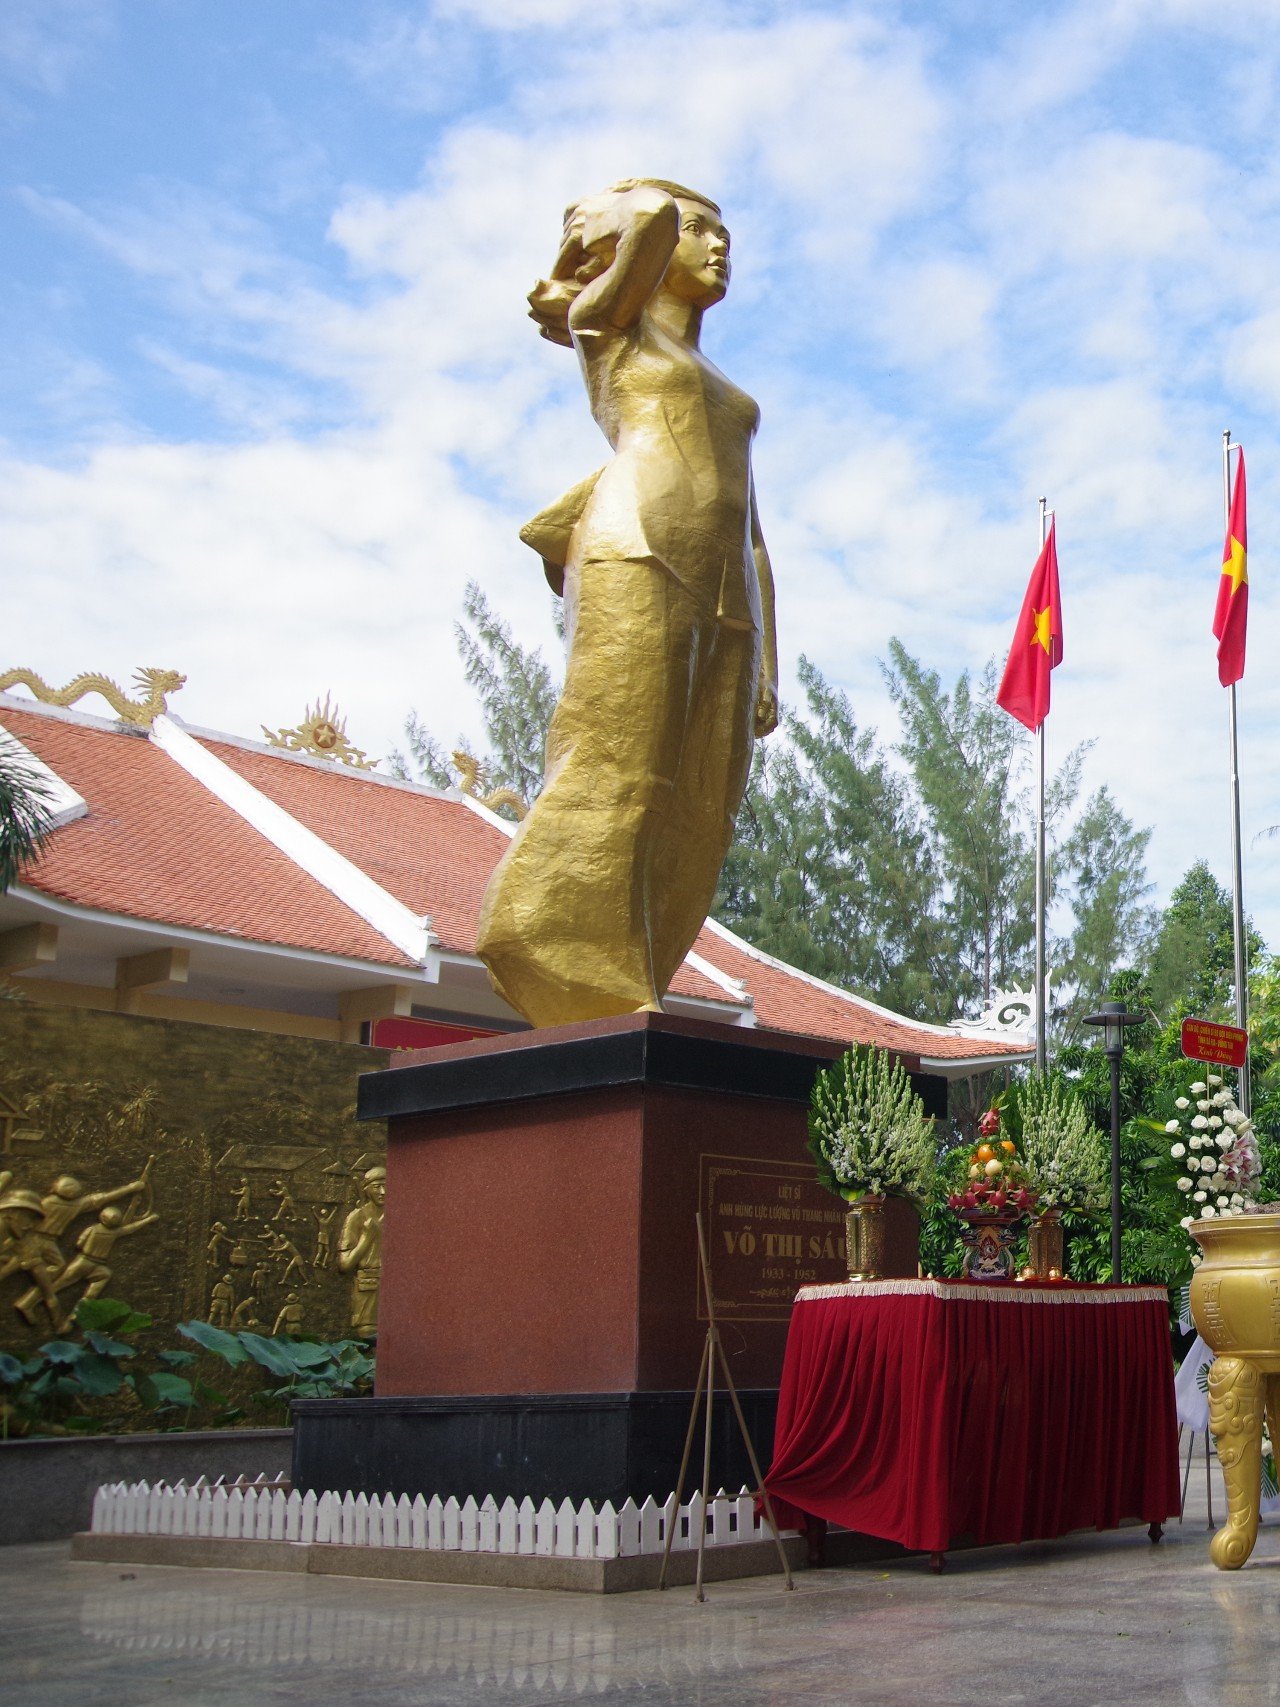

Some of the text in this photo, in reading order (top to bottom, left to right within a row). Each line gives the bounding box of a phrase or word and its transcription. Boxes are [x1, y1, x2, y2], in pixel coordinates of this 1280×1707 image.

[719, 1203, 733, 1216] ANH
[735, 1202, 753, 1217] HÙNG
[802, 1208, 823, 1222] TRANG
[722, 1225, 756, 1256] VÕ
[762, 1233, 803, 1265] THỊ
